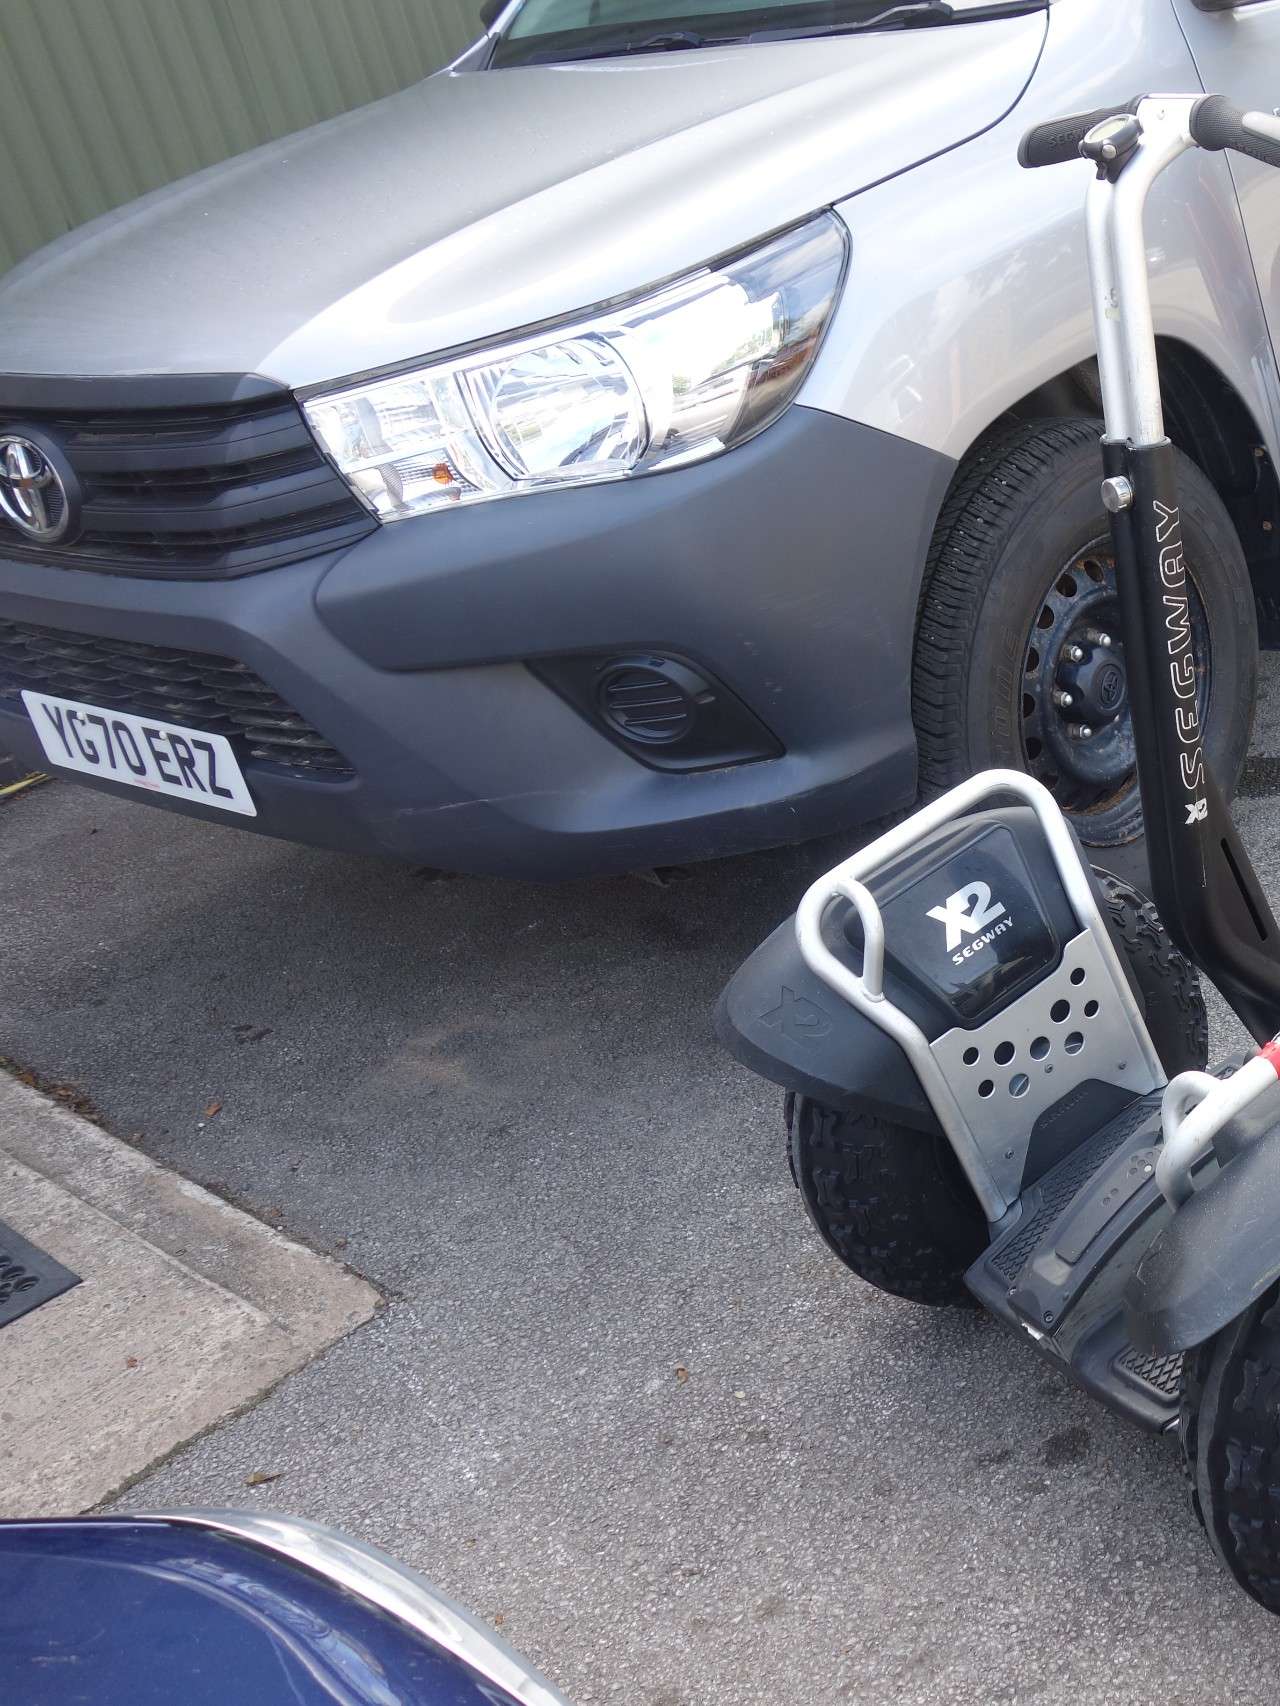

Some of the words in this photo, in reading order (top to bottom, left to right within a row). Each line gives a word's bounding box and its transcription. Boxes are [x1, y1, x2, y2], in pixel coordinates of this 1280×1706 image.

[1153, 500, 1205, 790] SEGWAY
[41, 703, 147, 776] YG70
[142, 727, 234, 799] ERZ
[925, 881, 1006, 952] X2
[952, 916, 1014, 966] SEGWAY
